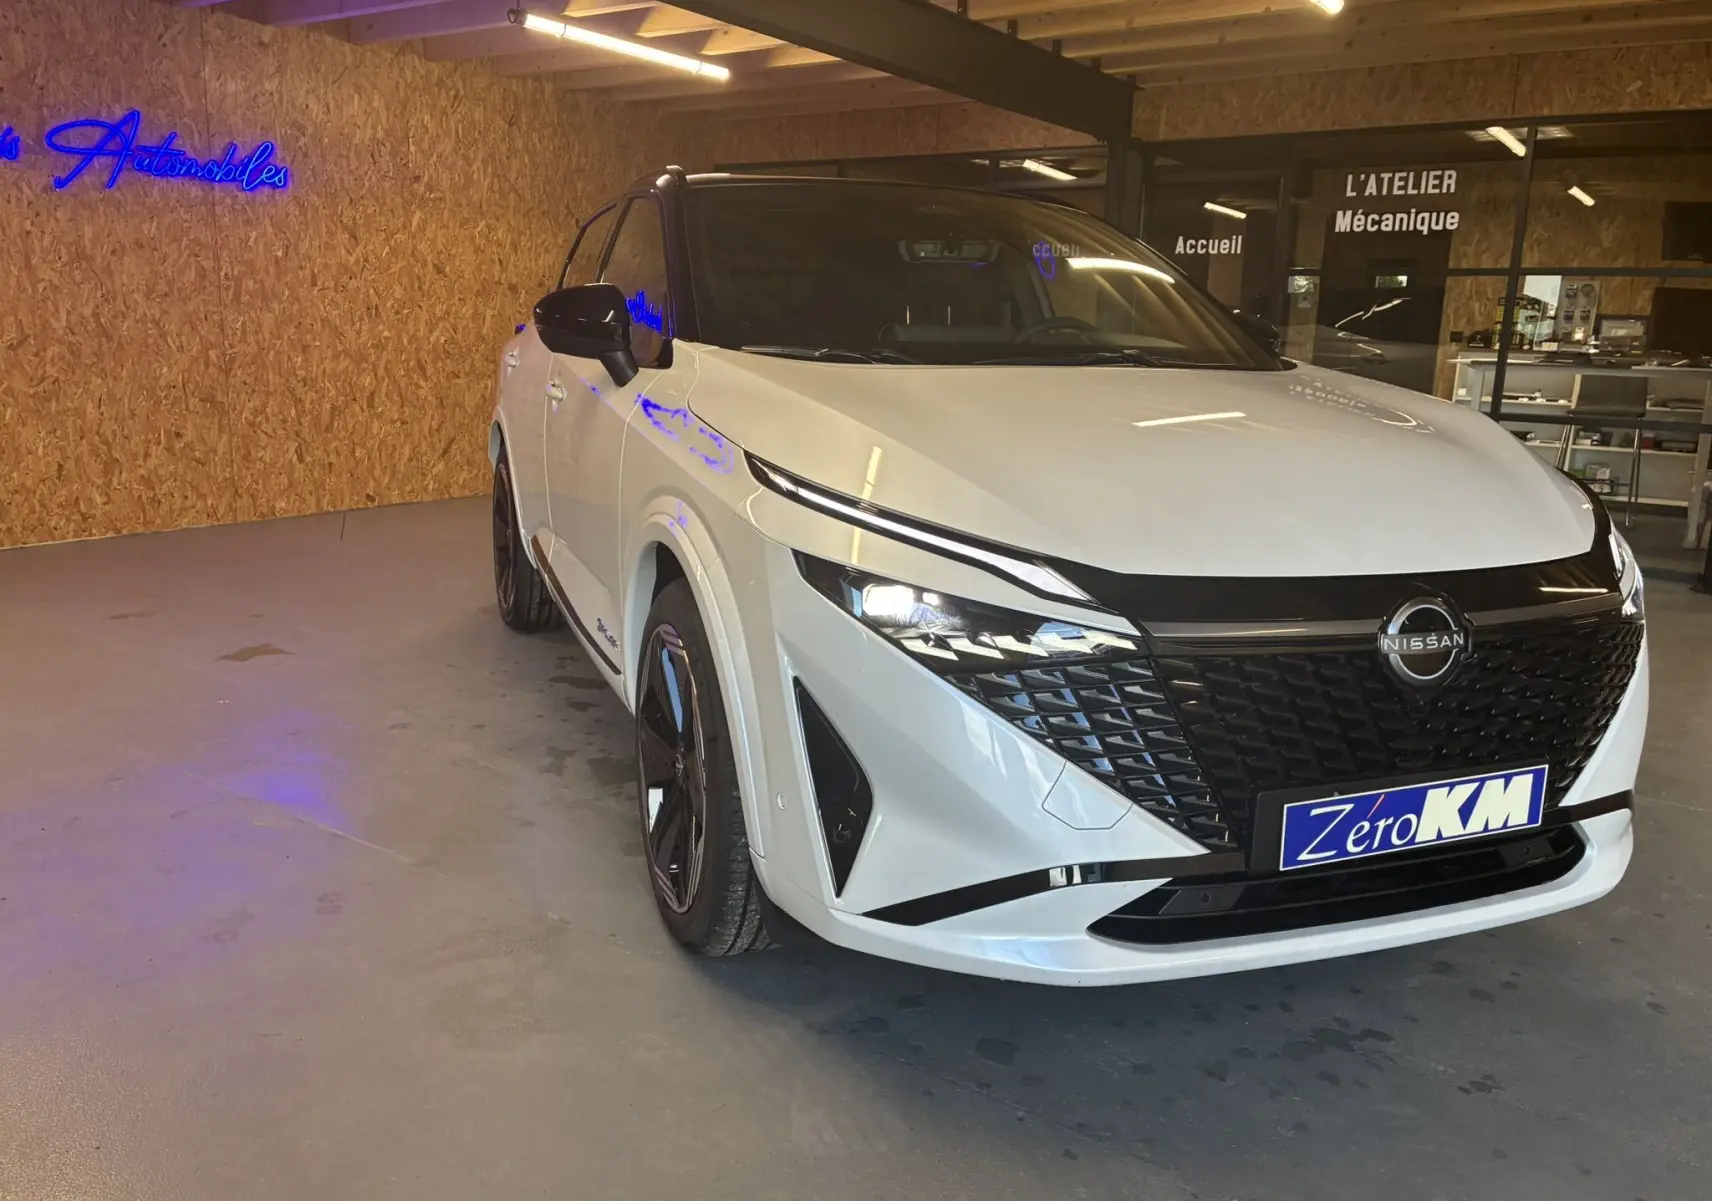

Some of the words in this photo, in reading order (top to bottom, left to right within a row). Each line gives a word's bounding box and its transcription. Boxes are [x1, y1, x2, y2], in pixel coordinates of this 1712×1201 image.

[45, 110, 288, 190] Automobiles
[1345, 170, 1457, 197] L'ATELIER
[1335, 208, 1460, 235] Mécanique
[1175, 235, 1242, 254] Accueil
[1383, 632, 1464, 651] NISSAN
